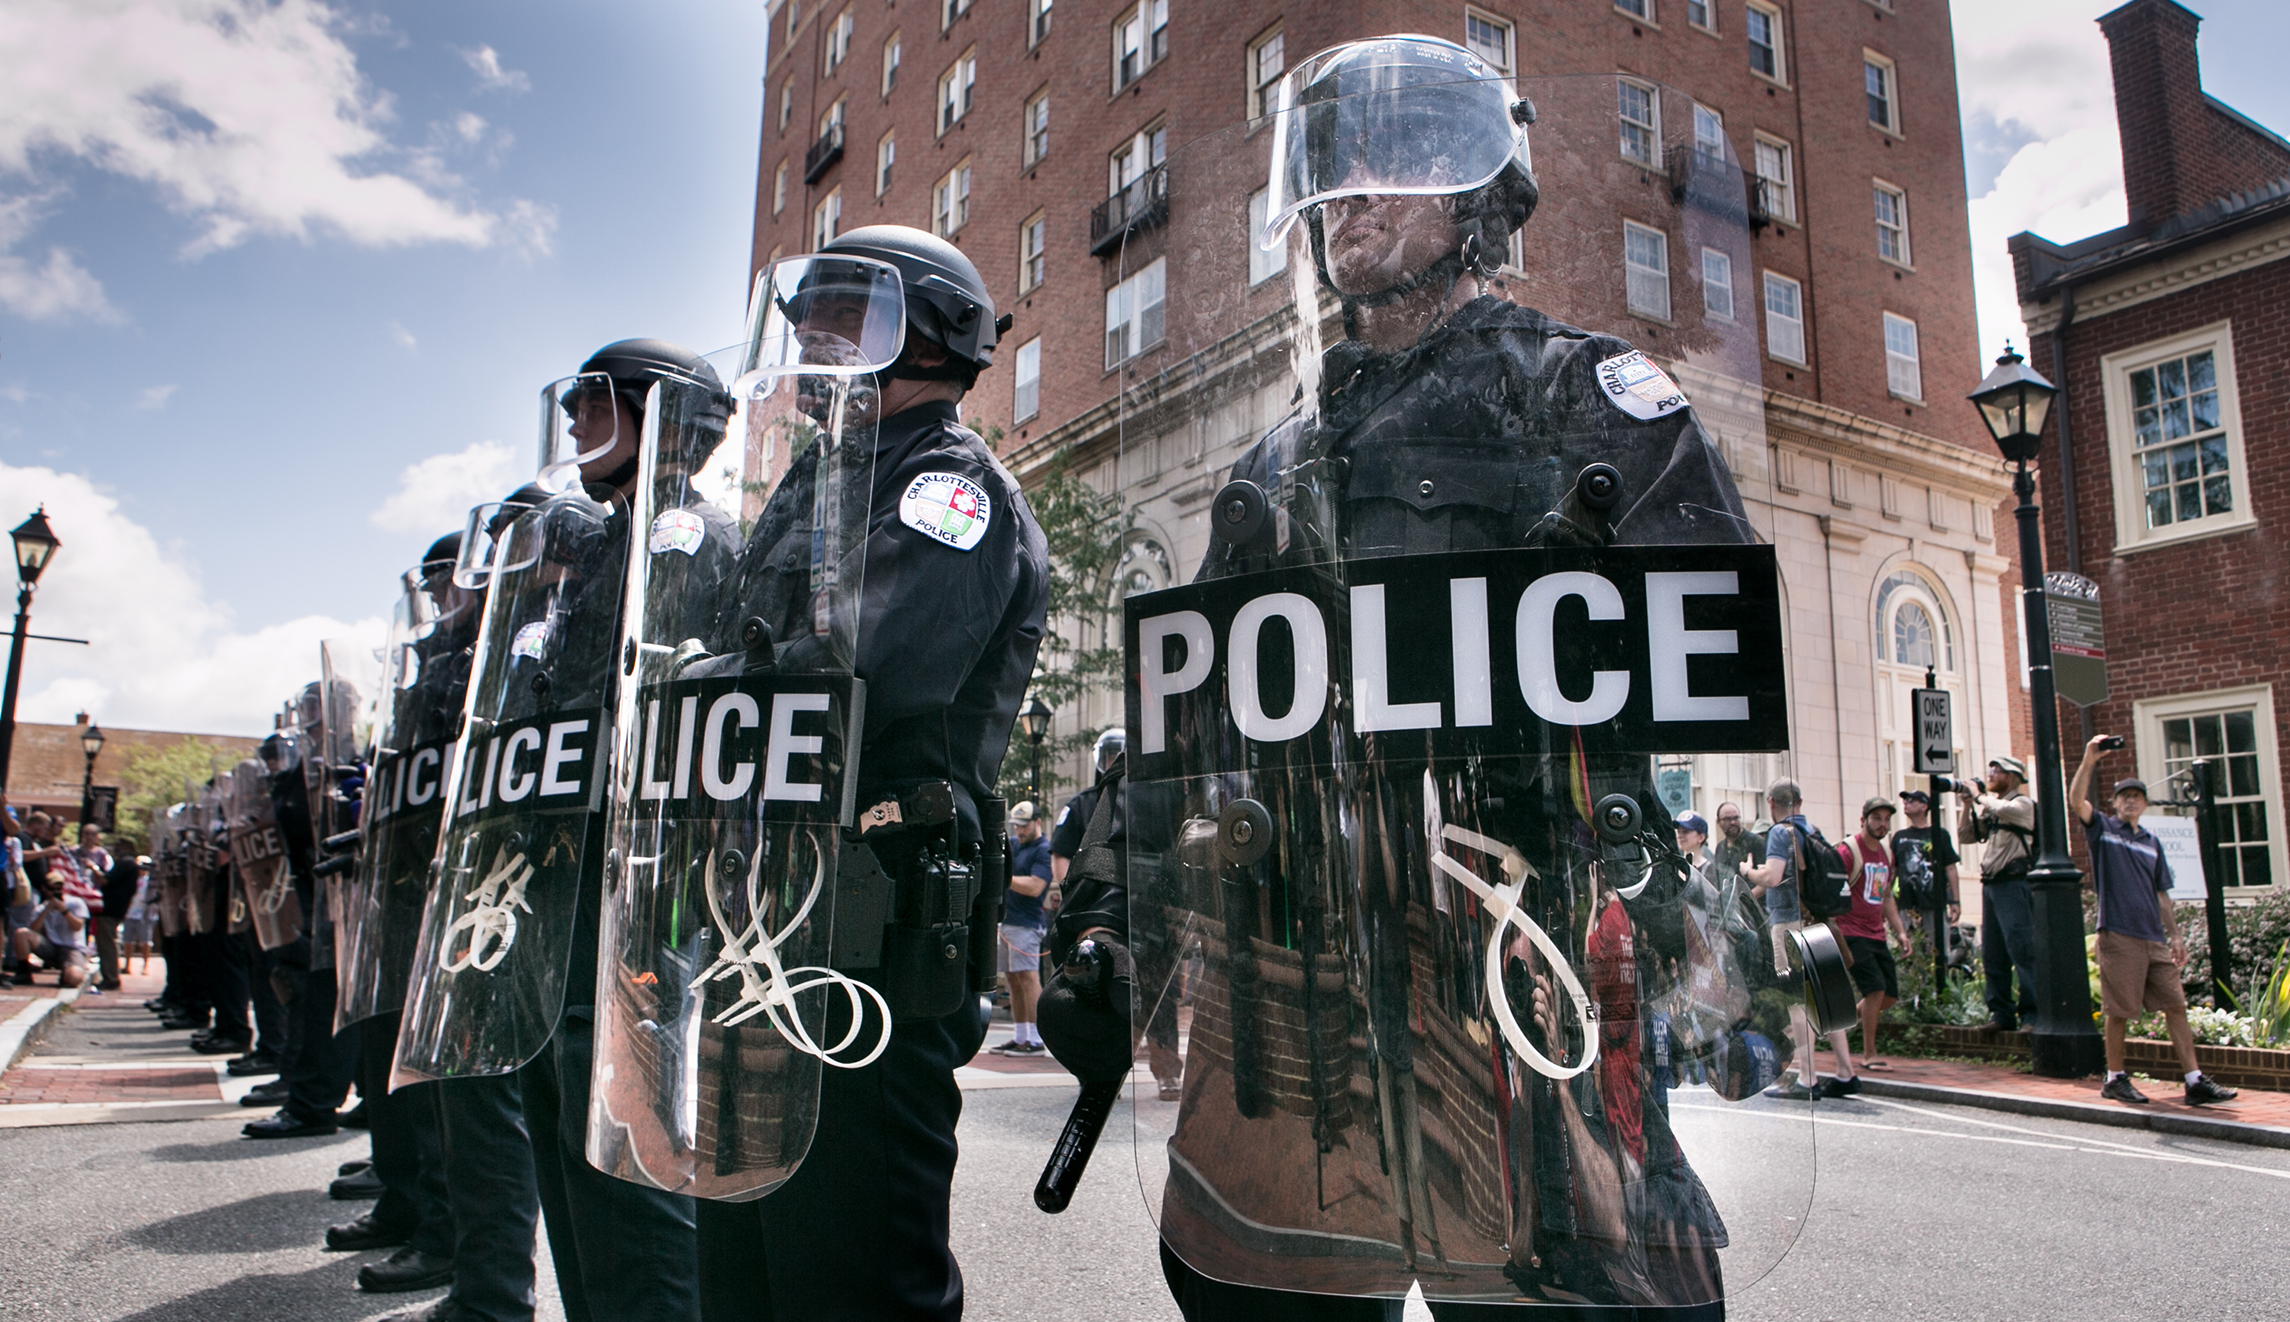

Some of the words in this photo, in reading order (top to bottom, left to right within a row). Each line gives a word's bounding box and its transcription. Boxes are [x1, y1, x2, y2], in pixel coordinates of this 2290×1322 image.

[907, 475, 987, 523] CHARLOTTESVILLE
[915, 519, 958, 544] POLICE
[1139, 570, 1750, 755] POLICE
[1924, 697, 1946, 717] ONE
[1924, 720, 1947, 740] WAY
[374, 741, 456, 823] LIC
[457, 719, 589, 818] LICE
[240, 827, 280, 863] LICE
[2152, 828, 2195, 838] AISSANCE
